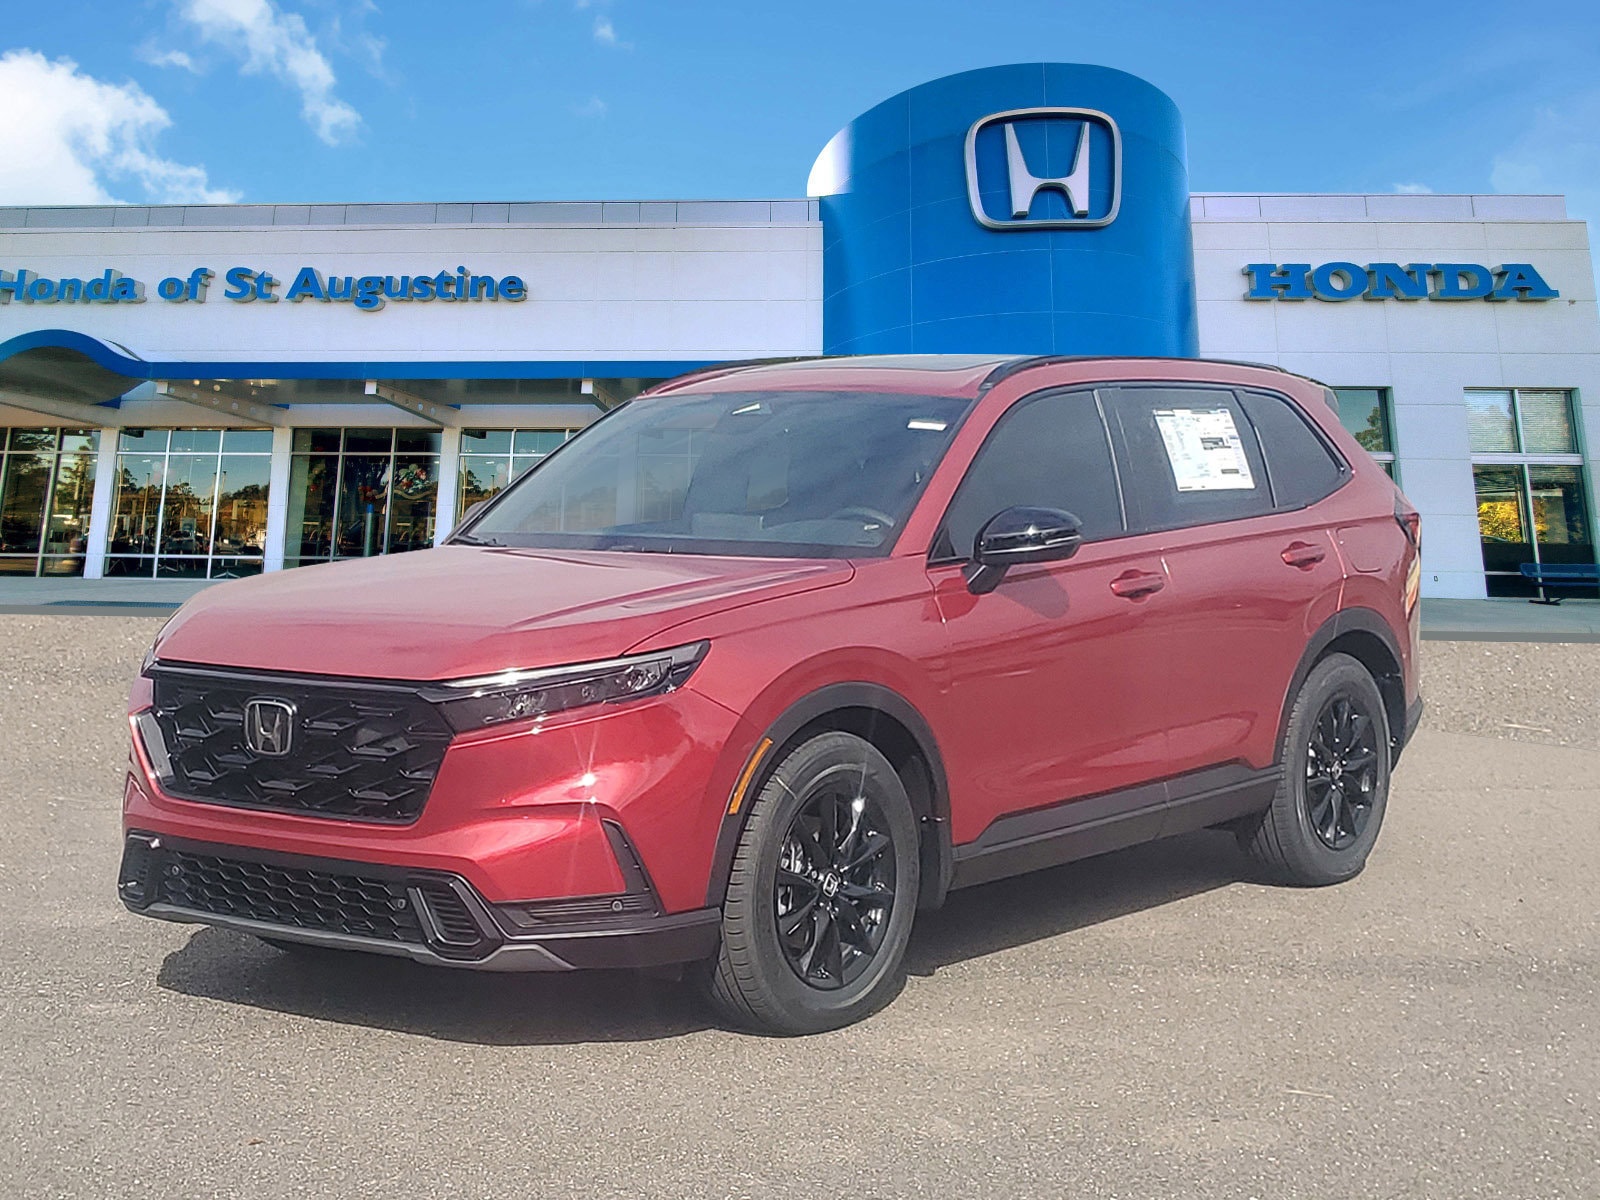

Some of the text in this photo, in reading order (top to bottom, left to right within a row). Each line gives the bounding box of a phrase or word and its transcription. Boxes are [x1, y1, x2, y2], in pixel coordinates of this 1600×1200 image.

[0, 265, 527, 312] Honda of St Augustine
[1243, 261, 1560, 302] HONDA
